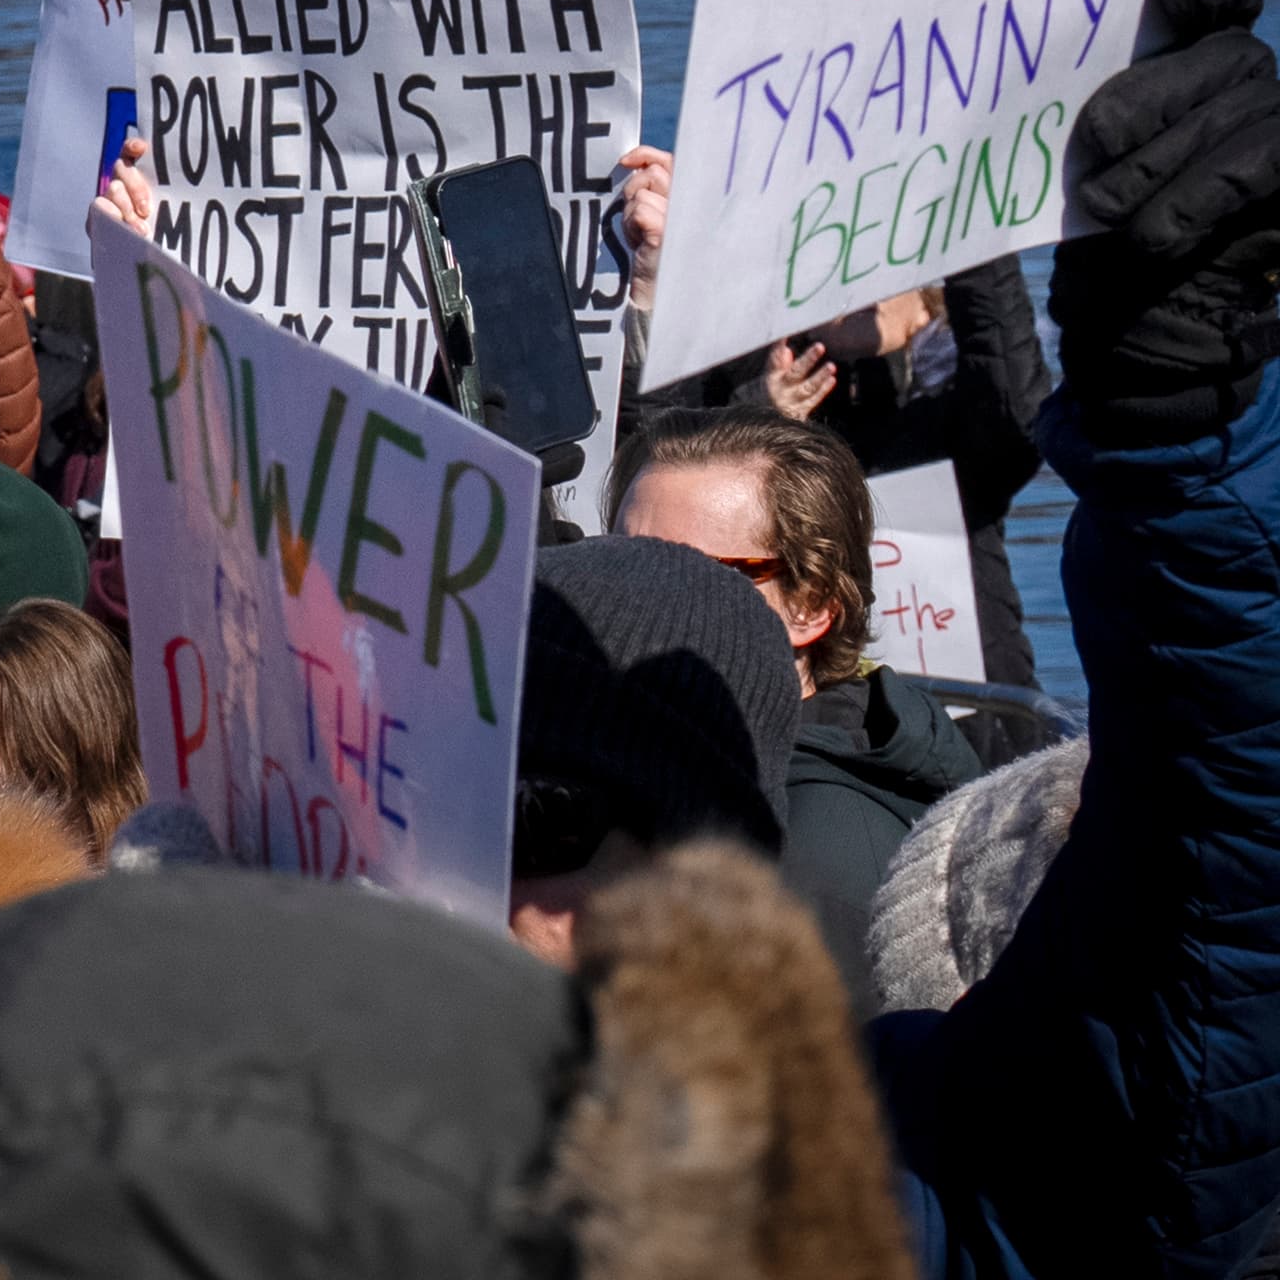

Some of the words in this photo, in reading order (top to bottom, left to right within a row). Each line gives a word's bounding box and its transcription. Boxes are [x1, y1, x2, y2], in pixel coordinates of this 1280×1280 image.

[151, 69, 348, 191] POWER
[374, 71, 448, 191] IS
[463, 69, 616, 194] THE
[785, 100, 1066, 309] BEGINS
[153, 196, 304, 307] MOST
[136, 261, 507, 727] POWER
[881, 582, 955, 636] the
[286, 643, 409, 833] THE
